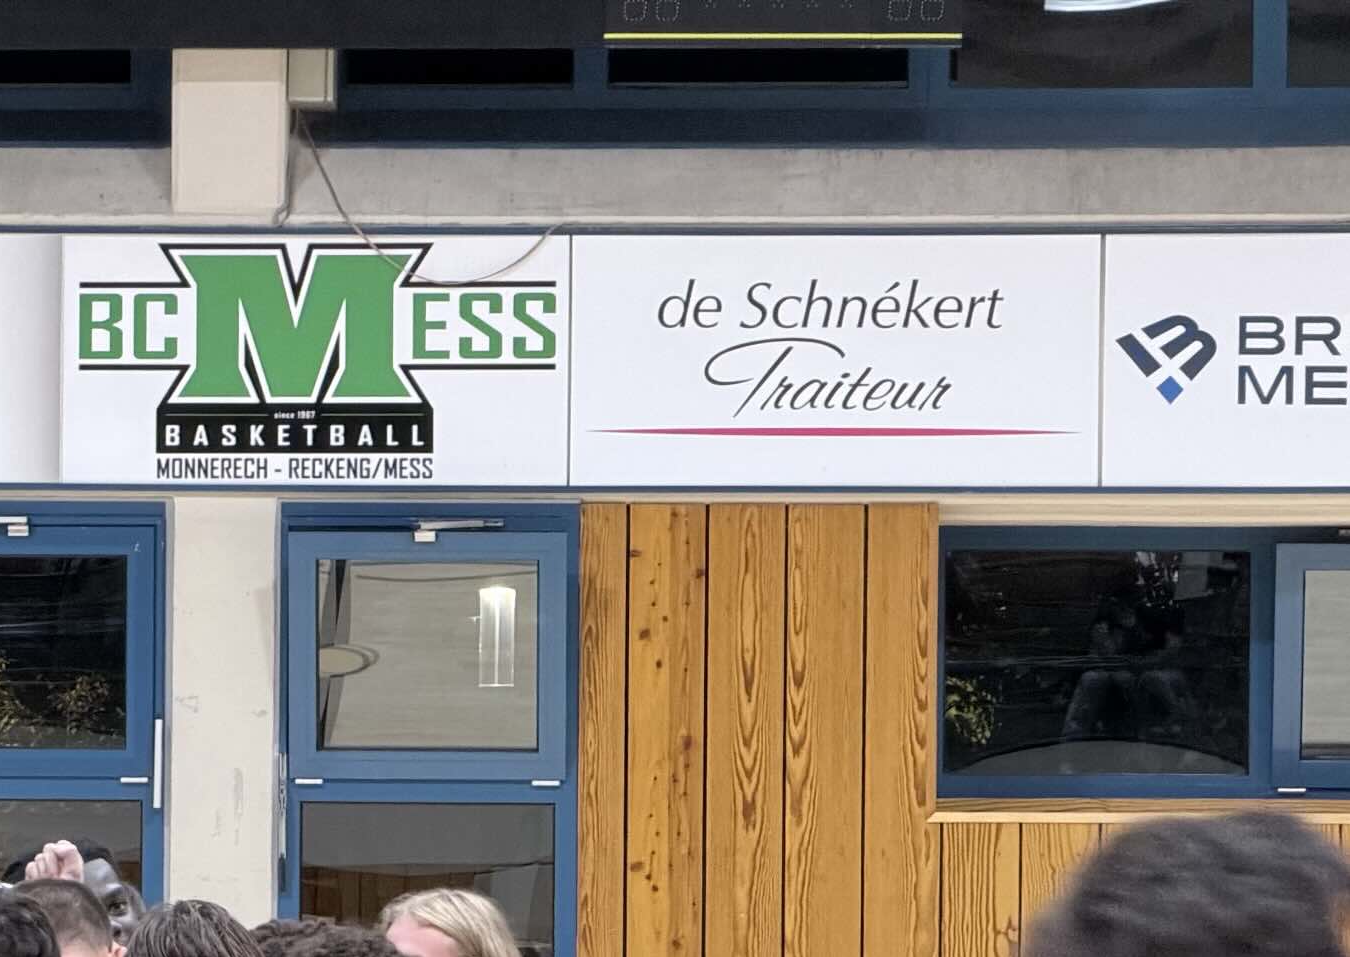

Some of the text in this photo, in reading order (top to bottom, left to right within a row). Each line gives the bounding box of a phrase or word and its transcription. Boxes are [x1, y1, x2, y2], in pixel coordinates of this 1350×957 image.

[79, 293, 179, 360] BC
[658, 279, 1004, 330] de Schnékert
[704, 337, 952, 418] Traiteur
[164, 424, 425, 447] BASKETBALL
[156, 457, 268, 480] MONNERECH
[288, 457, 434, 480] RECKENG/MESS
